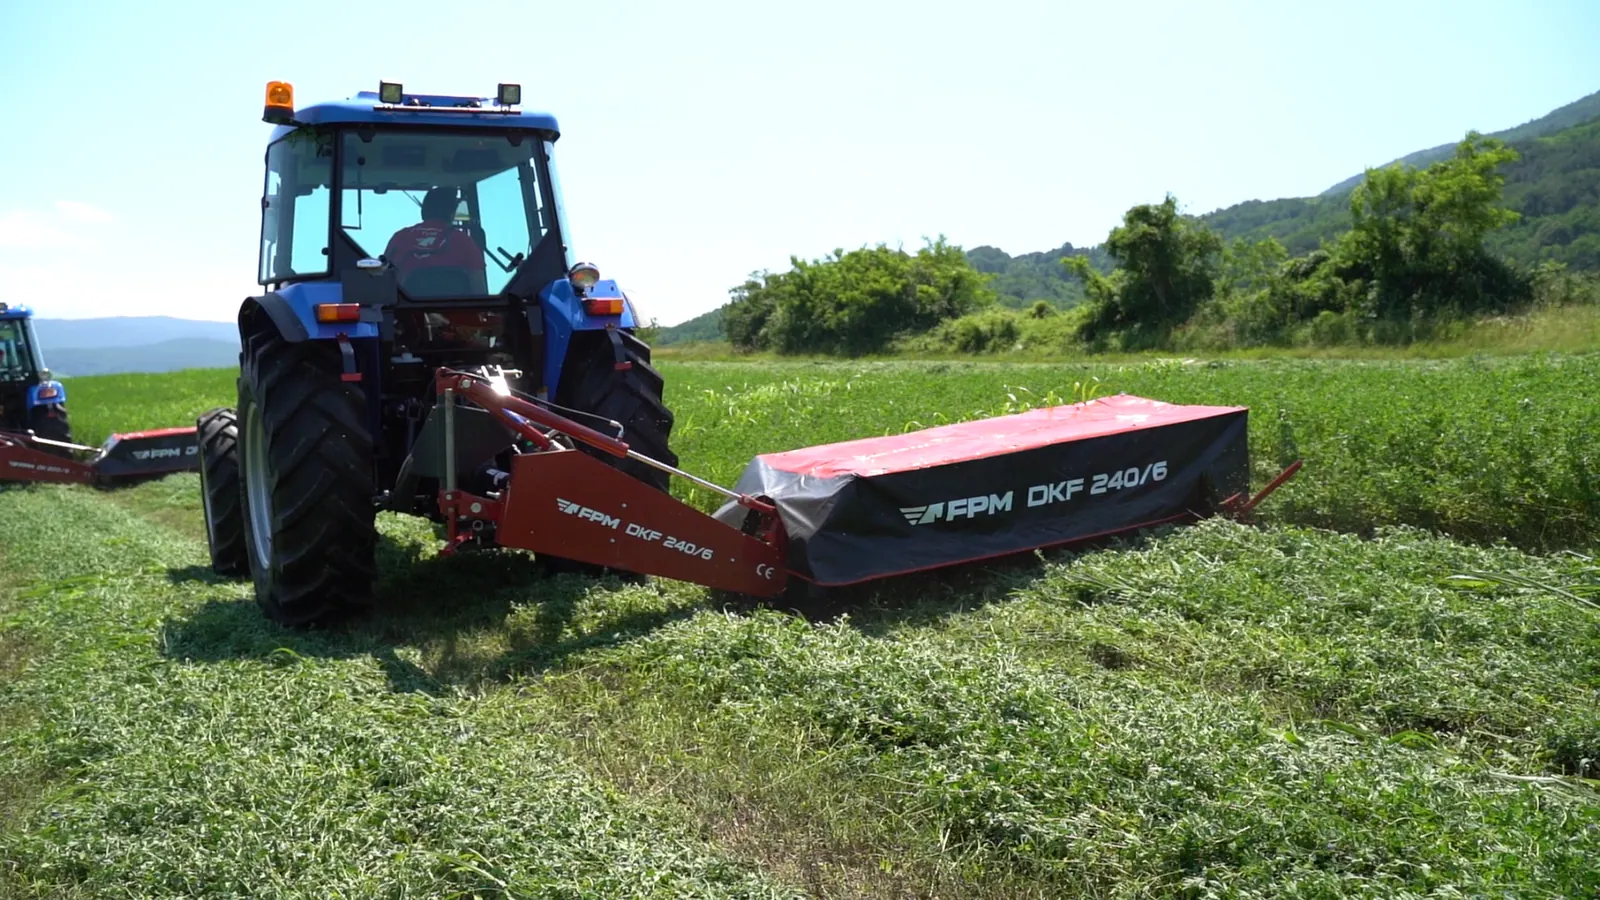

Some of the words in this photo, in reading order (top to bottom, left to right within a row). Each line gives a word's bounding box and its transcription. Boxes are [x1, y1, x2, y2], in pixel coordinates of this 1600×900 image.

[946, 490, 1014, 522] FPM
[1027, 478, 1085, 508] DKF
[1090, 460, 1168, 495] 240/6
[578, 507, 621, 530] FPM
[625, 523, 663, 543] DKF
[662, 536, 714, 561] 240/6
[757, 564, 775, 580] CE
